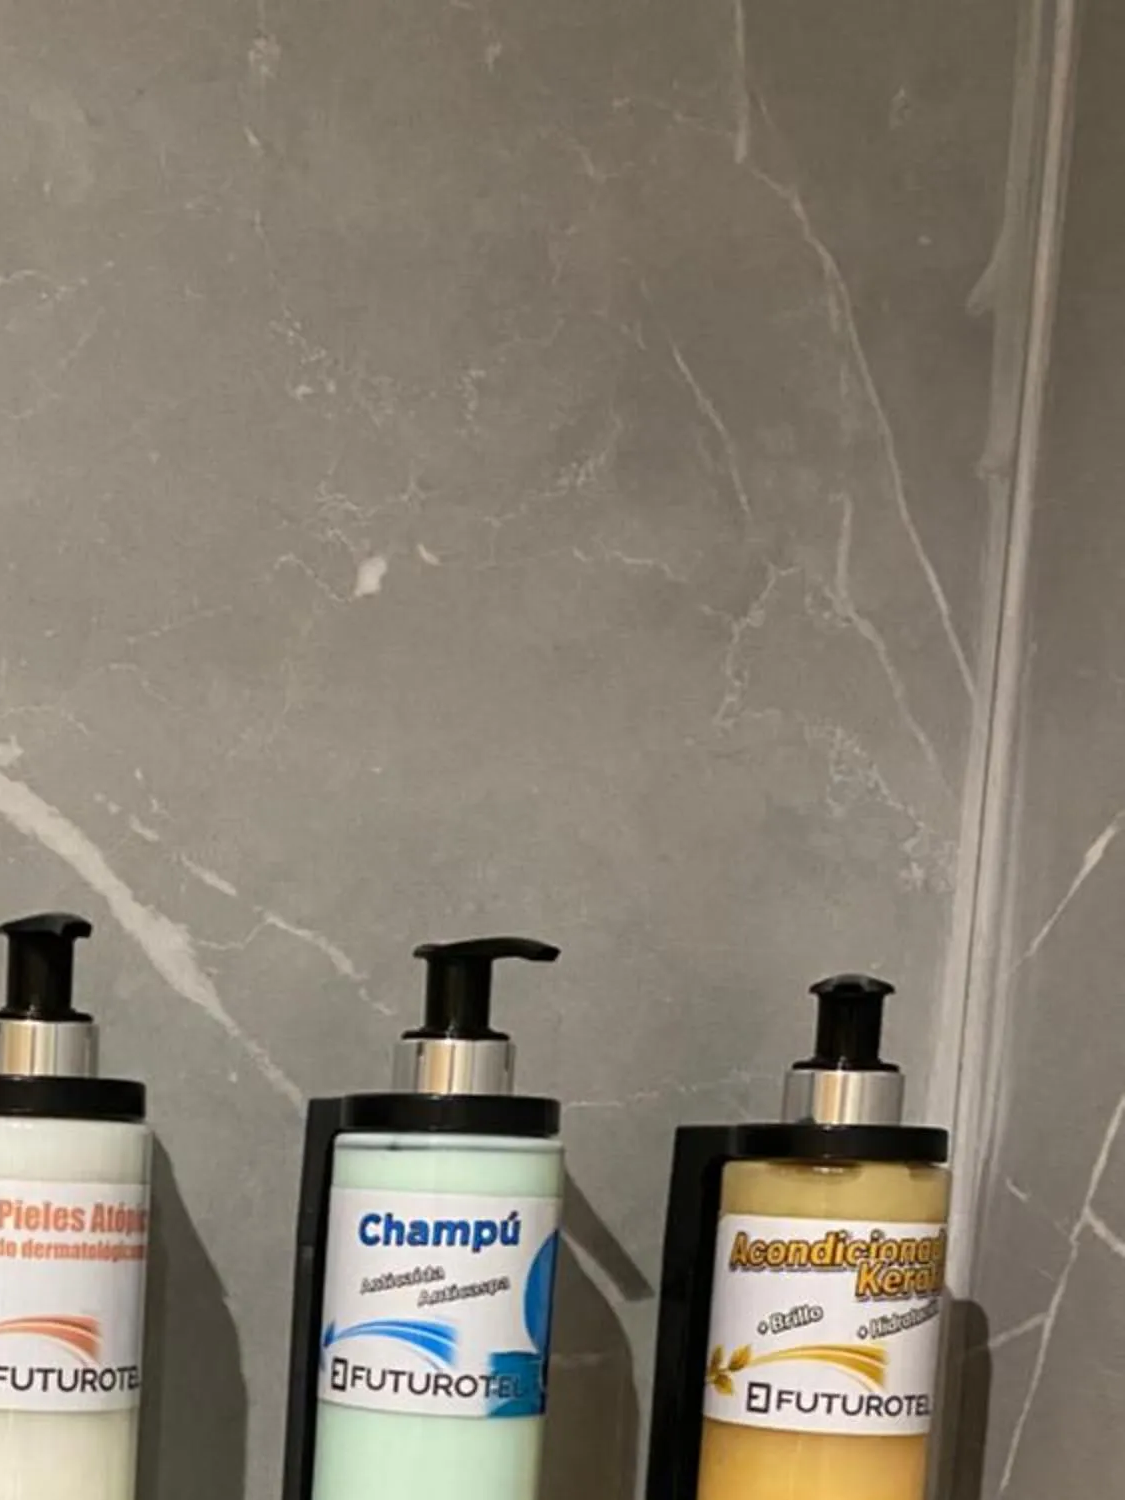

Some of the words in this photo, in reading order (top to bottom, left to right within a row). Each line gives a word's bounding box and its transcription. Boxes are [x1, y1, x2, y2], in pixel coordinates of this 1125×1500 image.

[358, 1210, 522, 1253] Champú
[770, 1304, 824, 1335] Brillo
[776, 1389, 931, 1418] FUTUROTE
